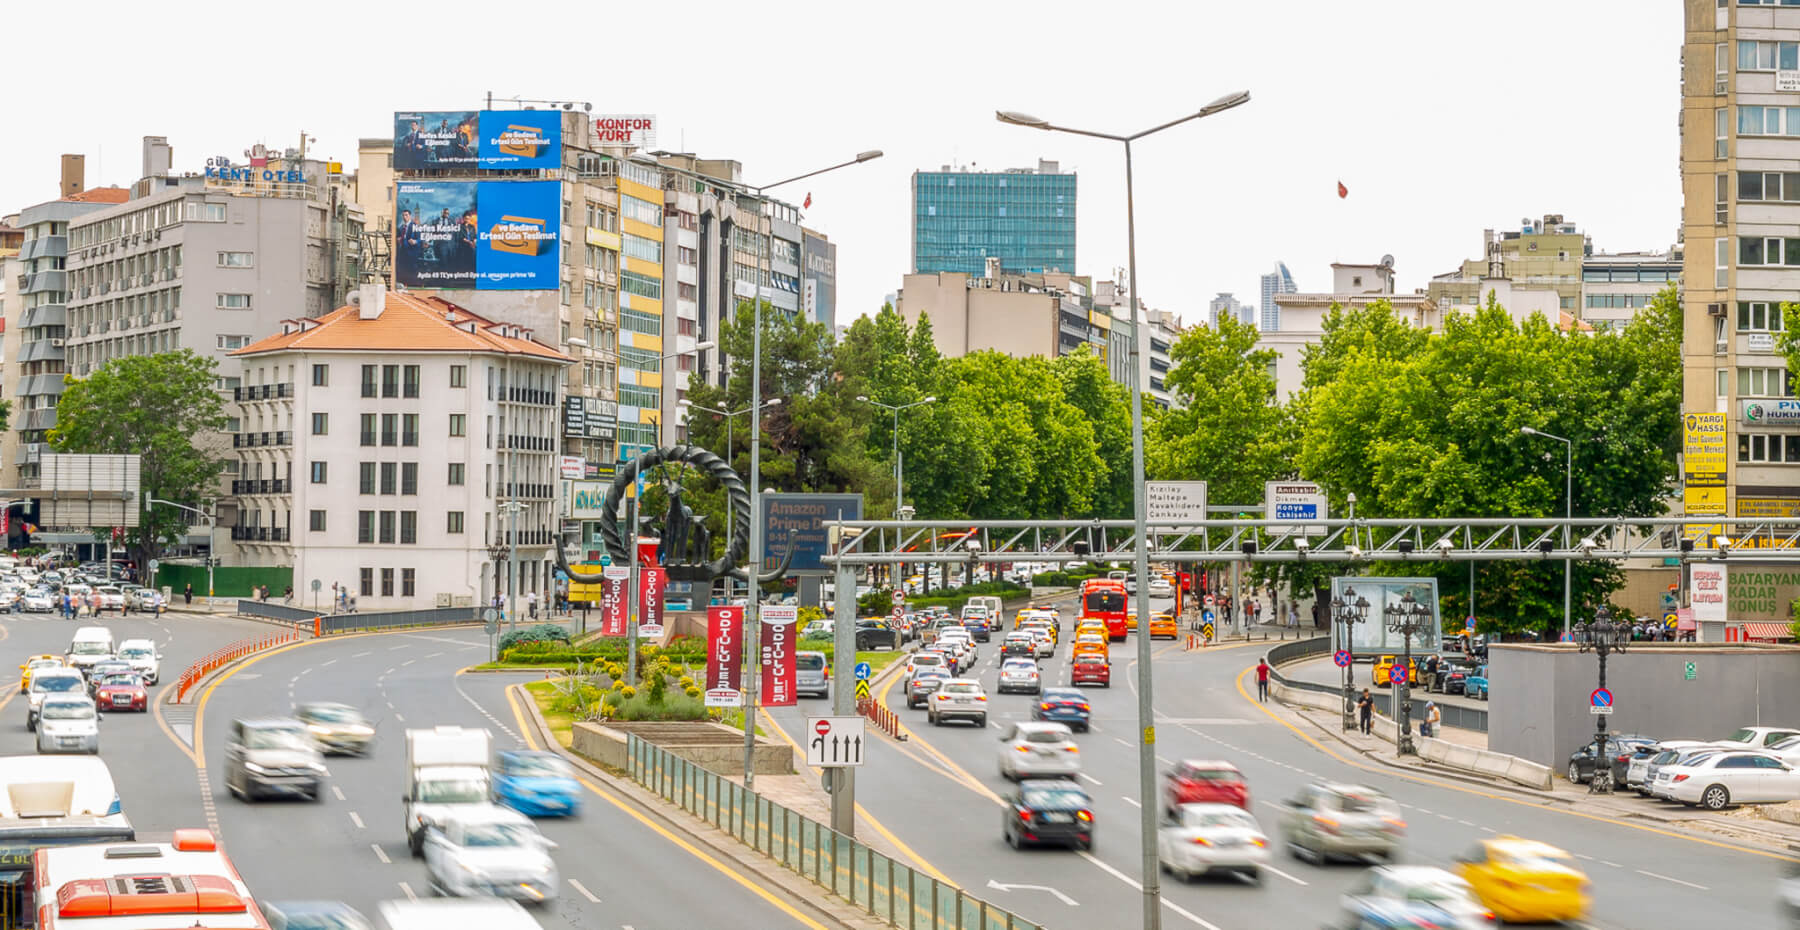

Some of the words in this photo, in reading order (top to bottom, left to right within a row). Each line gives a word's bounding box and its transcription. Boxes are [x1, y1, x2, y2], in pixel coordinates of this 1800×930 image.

[596, 118, 652, 130] KONFOR
[596, 130, 633, 142] YURT
[205, 167, 250, 181] KENT
[262, 169, 307, 183] OTEL
[412, 223, 435, 233] Nefes
[509, 224, 539, 232] Bedava
[420, 233, 452, 243] Eğlence
[480, 231, 505, 240] Ertesi
[505, 231, 523, 240] Gün
[523, 231, 557, 240] Teslimat
[769, 502, 827, 515] Amazon
[768, 517, 810, 530] Prime
[1728, 586, 1777, 599] KADAR
[1728, 600, 1777, 617] KONUŞ
